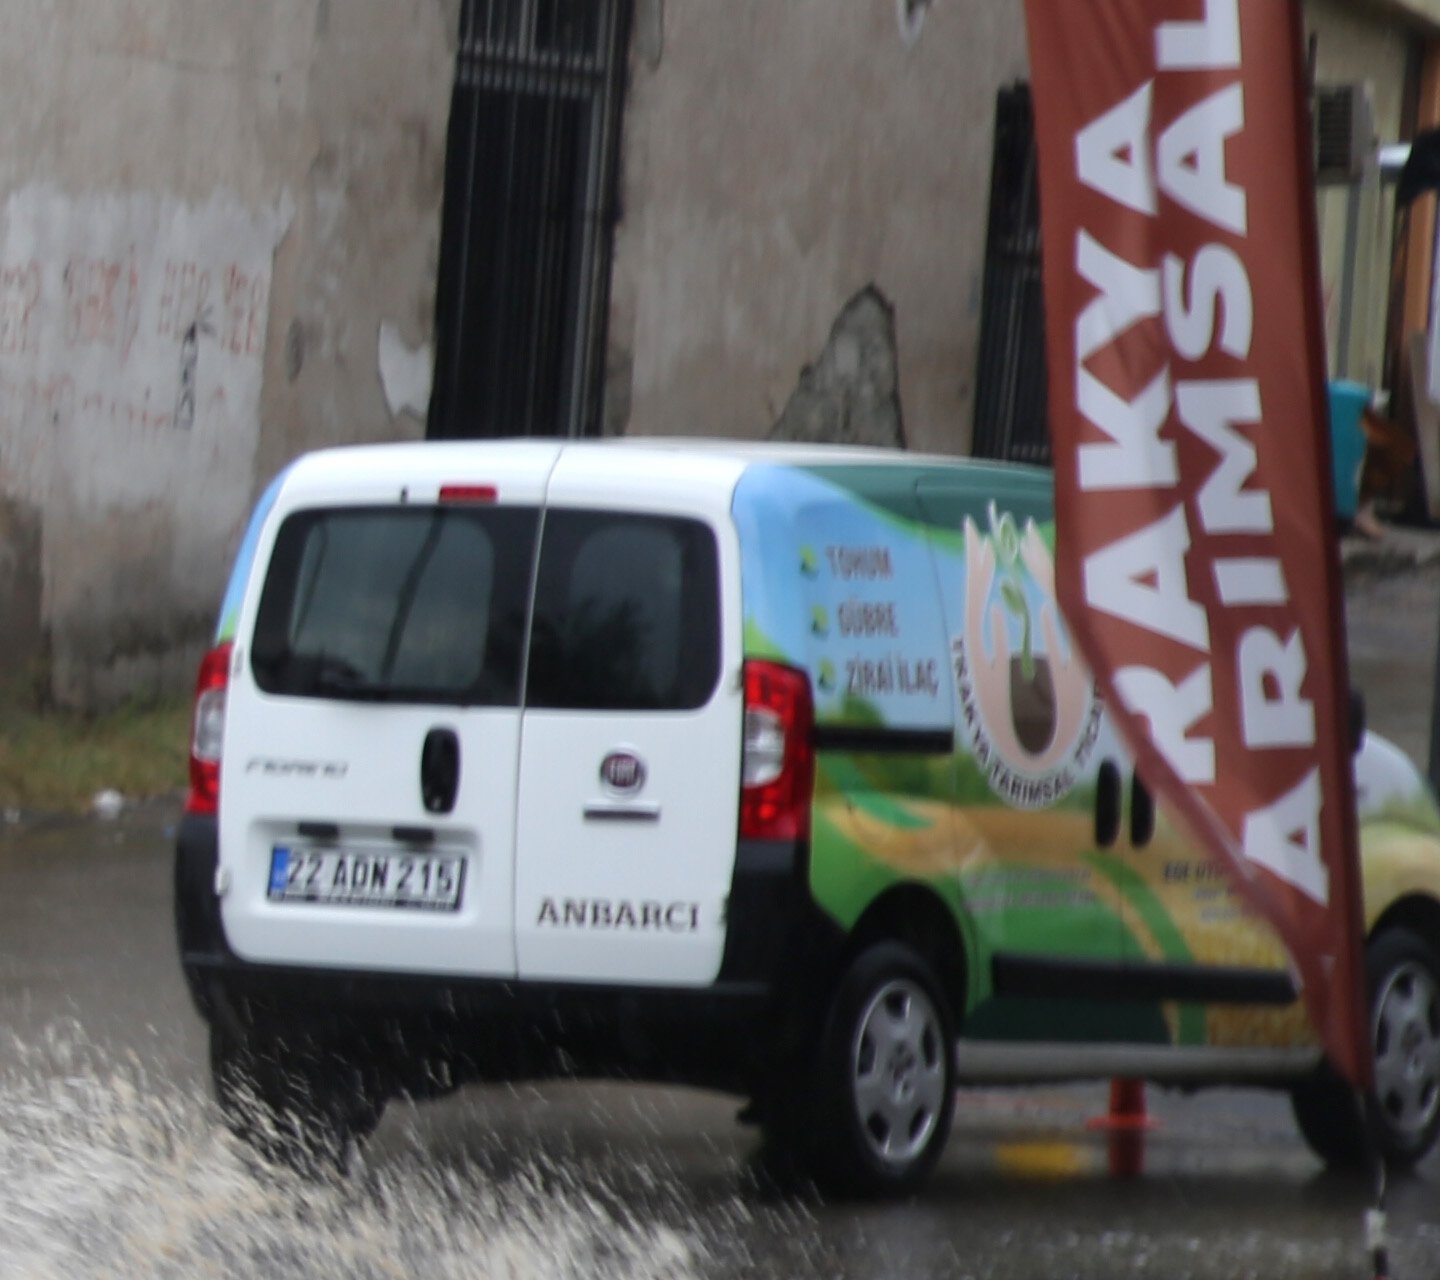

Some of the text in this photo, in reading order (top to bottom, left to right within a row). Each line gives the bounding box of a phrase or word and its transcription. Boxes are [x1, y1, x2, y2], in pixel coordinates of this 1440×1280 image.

[1077, 77, 1215, 786] RAKYA
[288, 849, 454, 897] 22 ADN 215
[537, 897, 701, 933] ANBARCI
